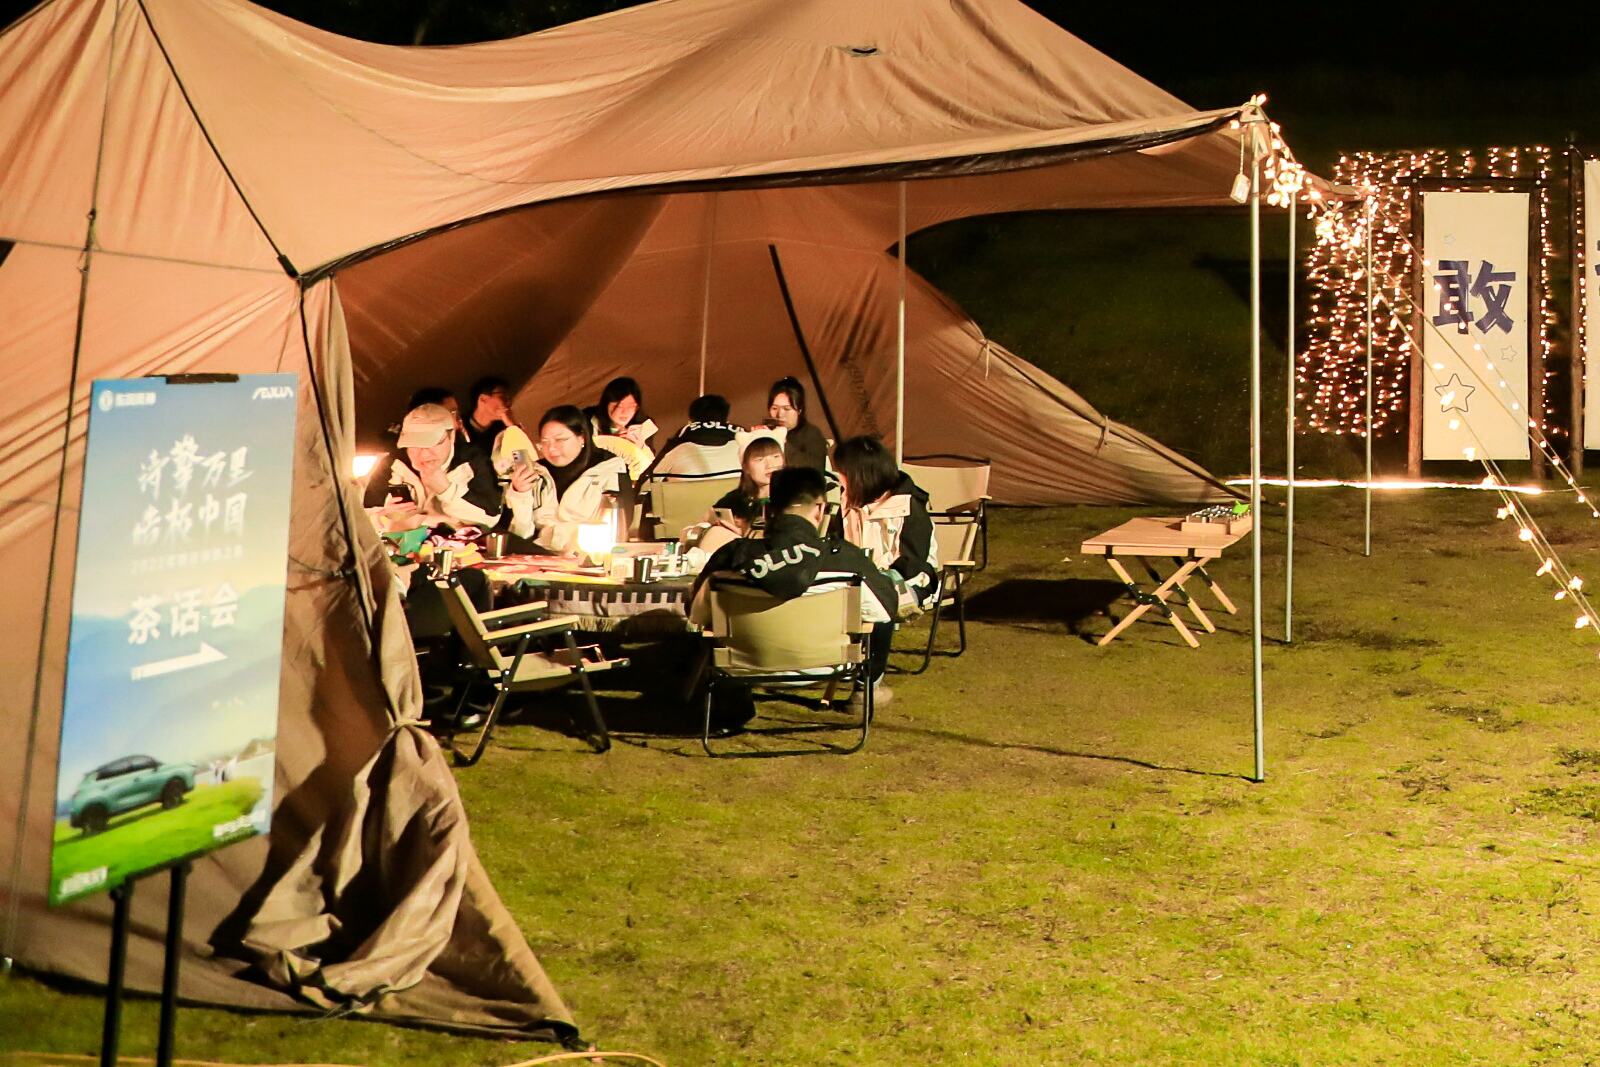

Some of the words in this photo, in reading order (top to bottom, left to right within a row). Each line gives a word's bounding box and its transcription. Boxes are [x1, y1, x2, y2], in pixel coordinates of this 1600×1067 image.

[1433, 259, 1517, 334] 敢
[127, 582, 240, 645] 茶话会
